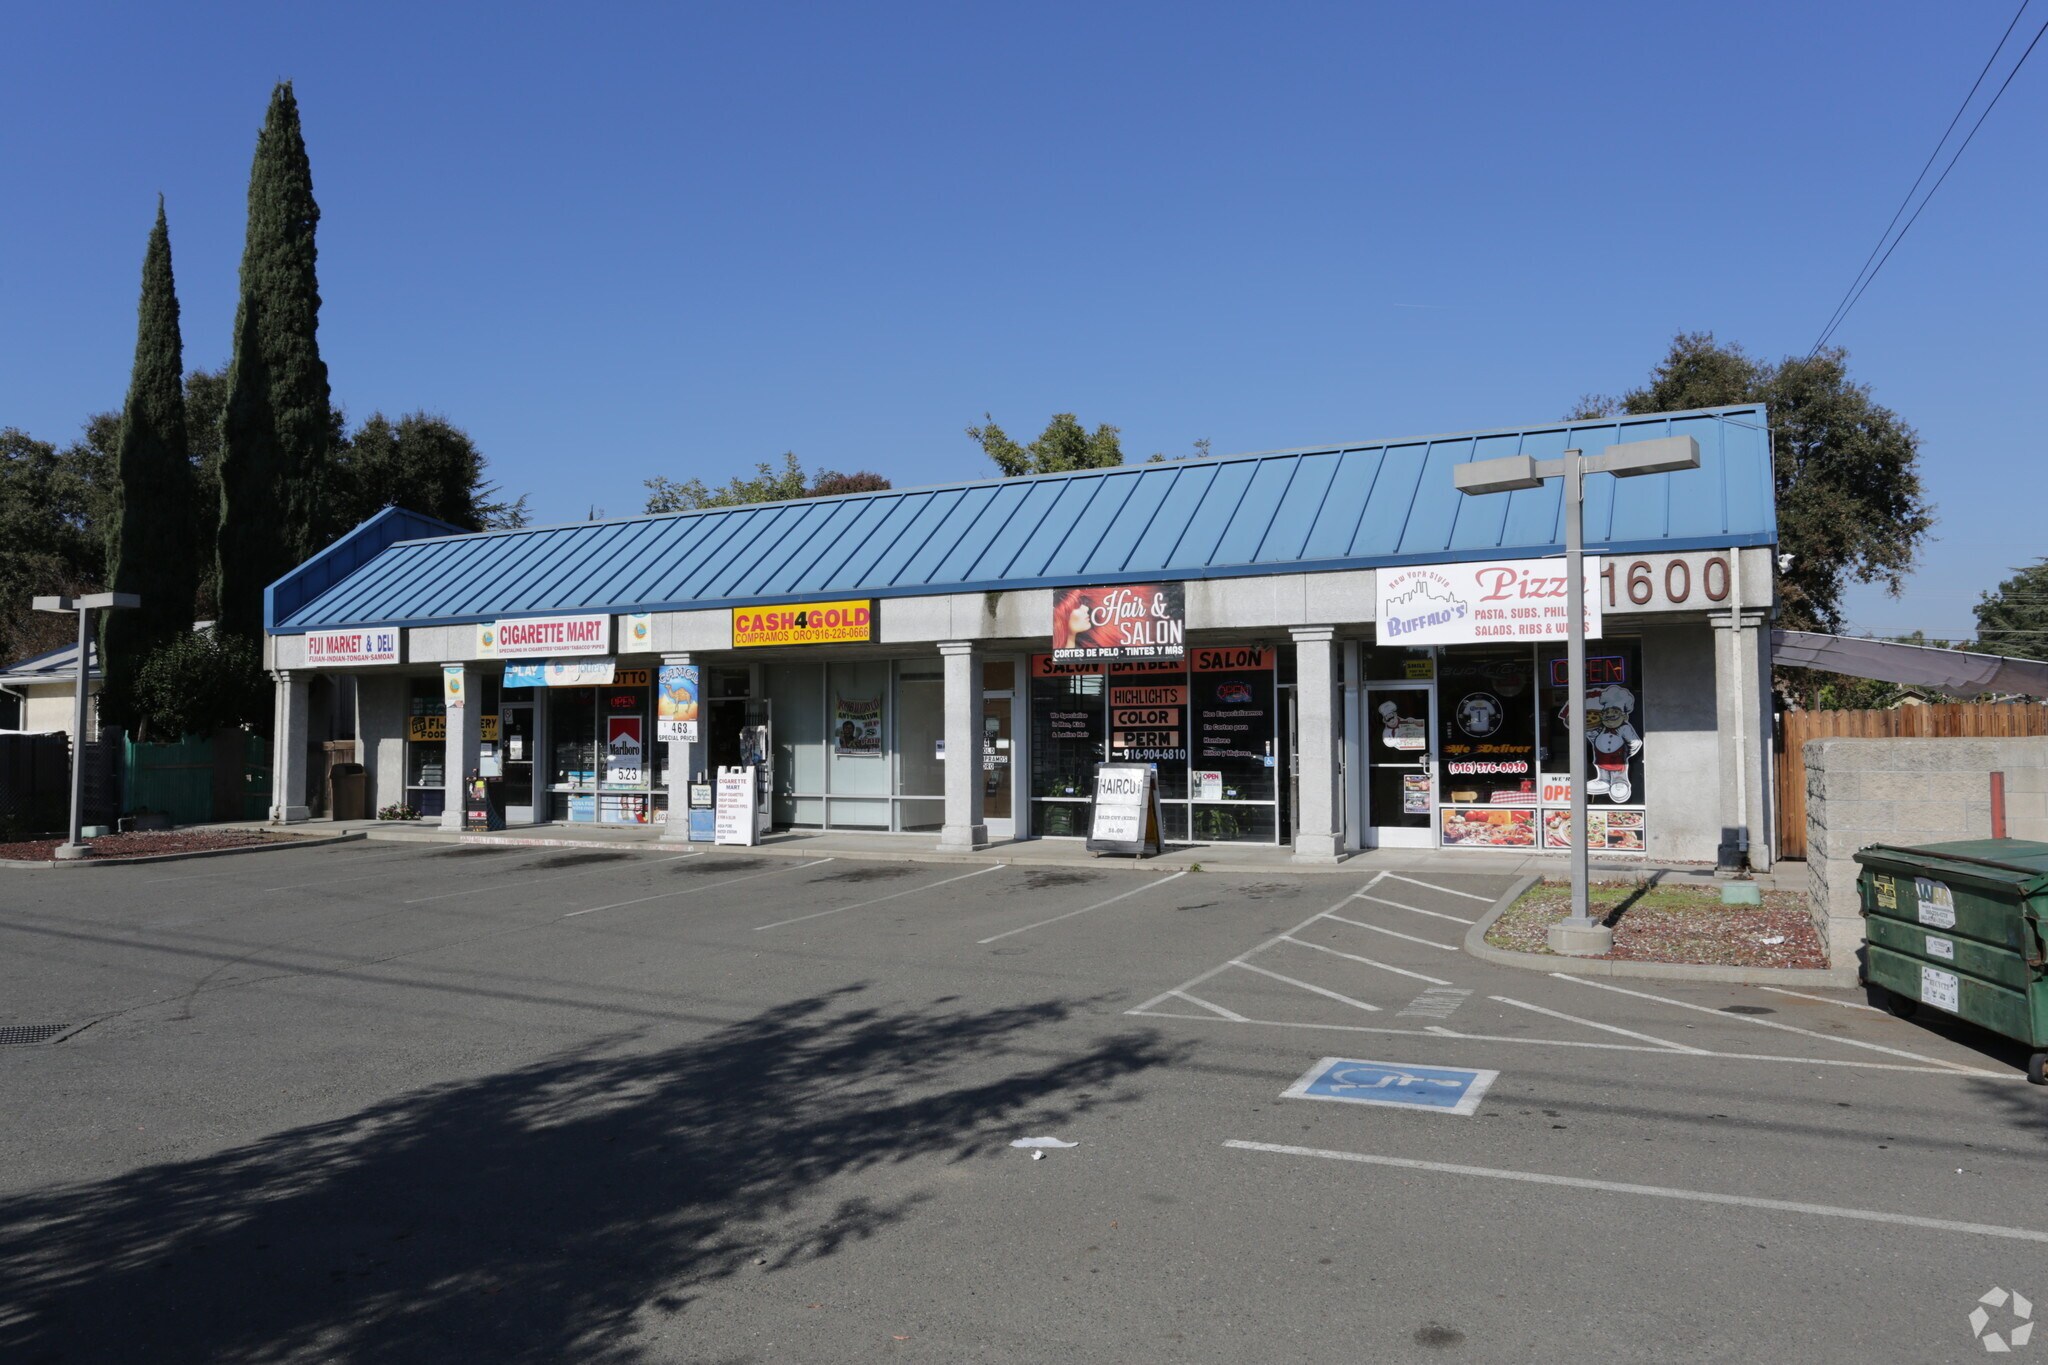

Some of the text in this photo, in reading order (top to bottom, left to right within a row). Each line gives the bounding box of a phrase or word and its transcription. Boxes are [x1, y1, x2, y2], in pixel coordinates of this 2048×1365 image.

[1389, 570, 1451, 590] New York Style
[1475, 567, 1589, 602] Pizz
[1601, 556, 1730, 607] 1600
[1091, 589, 1170, 627] Hair &
[735, 607, 870, 633] CASH4GOLD
[500, 620, 602, 646] CIGARETTE MART
[1120, 619, 1182, 646] SALON
[1519, 624, 1542, 635] RIBS
[1545, 623, 1553, 634] &
[1555, 622, 1590, 634] WIS
[308, 634, 394, 655] FIJI MARKET & DELI
[735, 630, 790, 644] COMPRAMOS
[1054, 649, 1084, 659] CORTES
[1086, 649, 1098, 657] DE
[1099, 648, 1119, 657] PELO
[1125, 646, 1155, 656] TINTES
[1157, 646, 1163, 655] Y
[1199, 651, 1262, 670] SALON
[614, 671, 647, 685] OTTO
[1553, 659, 1623, 683] OEN
[611, 696, 637, 708] OPEN
[1114, 688, 1178, 705] HIGHLIGHTS
[429, 718, 446, 730] FIJ
[1118, 710, 1169, 726] COLOR
[658, 734, 680, 742] SPECIAL
[1124, 732, 1171, 747] PERM
[609, 740, 640, 756] Marlboro
[1123, 748, 1186, 761] 916-904-6810
[1481, 743, 1532, 753] Deliver
[618, 767, 638, 781] 5.23
[1448, 761, 1477, 775] (916)
[1544, 785, 1571, 801] OPE
